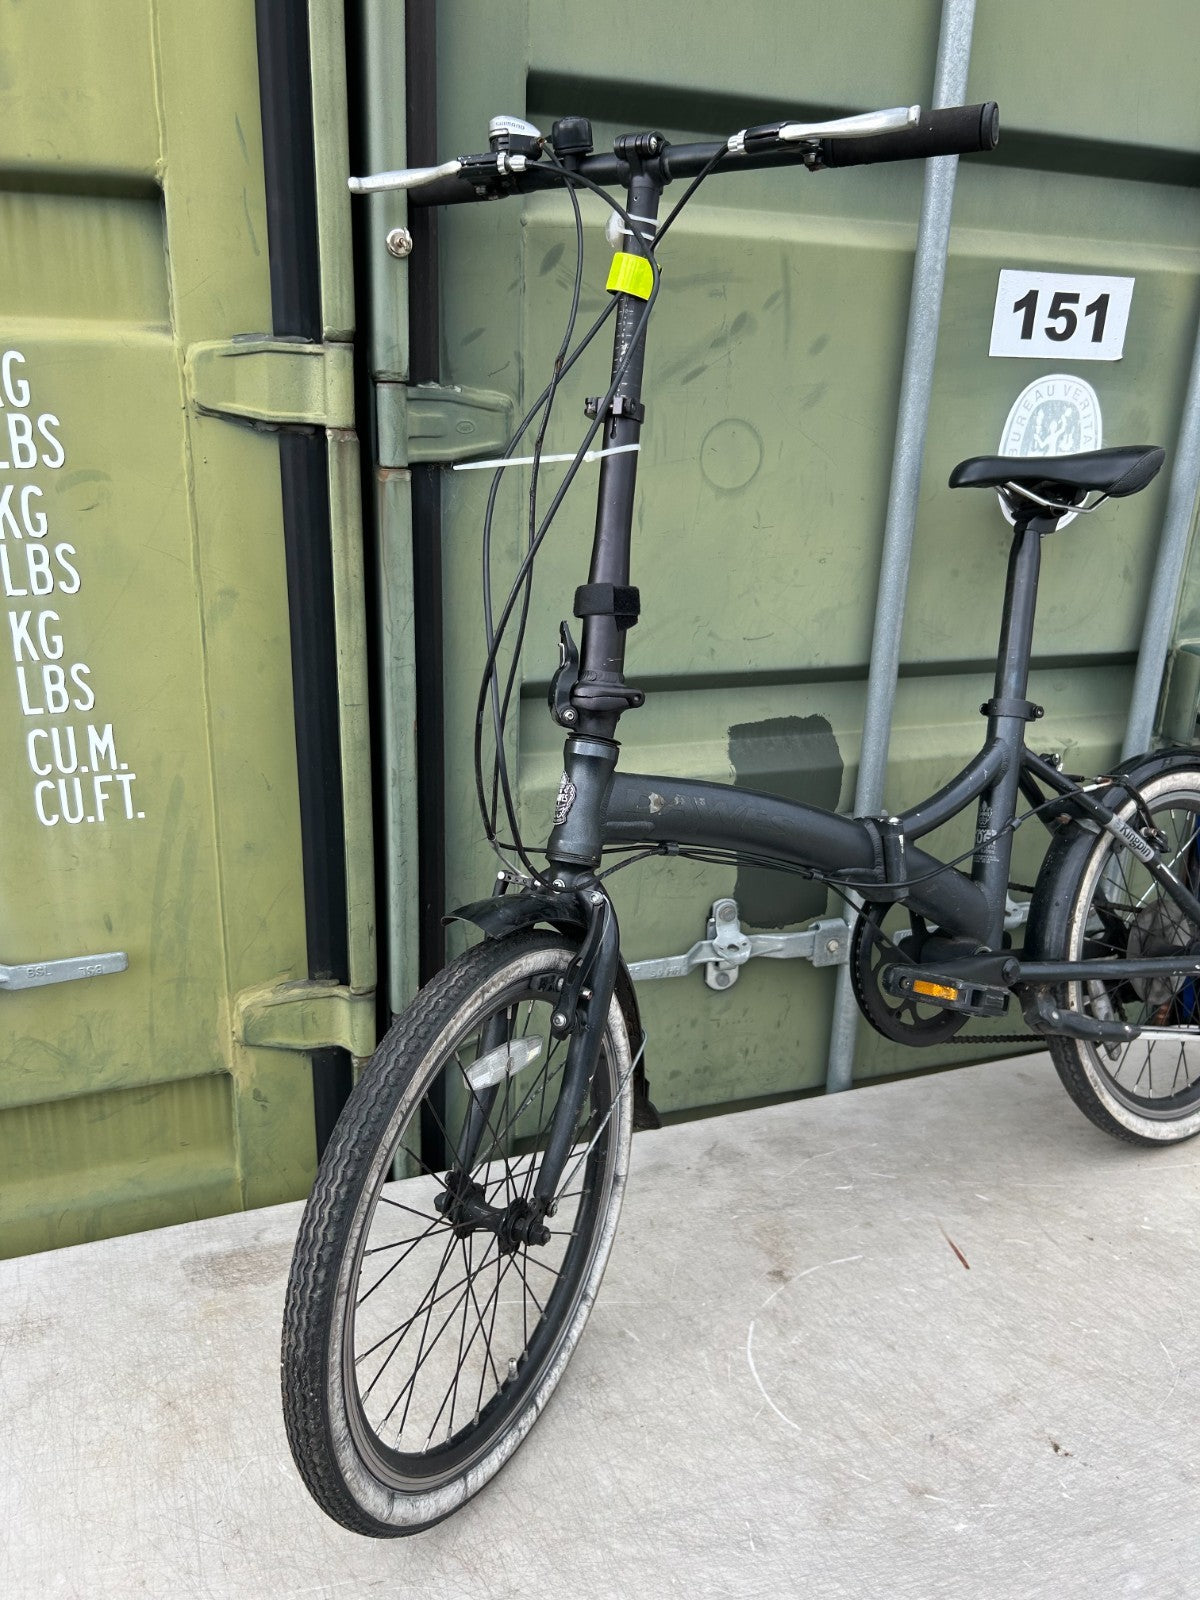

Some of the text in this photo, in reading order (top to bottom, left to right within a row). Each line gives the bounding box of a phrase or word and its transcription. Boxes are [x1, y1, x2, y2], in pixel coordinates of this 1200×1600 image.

[1012, 289, 1111, 343] 151
[0, 350, 31, 408] G
[0, 412, 65, 469] BS
[1009, 384, 1093, 456] BUREAU VERITA
[0, 484, 48, 540] KG
[0, 542, 81, 597] LBS
[9, 609, 64, 662] KG
[17, 662, 95, 716] LBS
[27, 723, 129, 776] CU.M.
[34, 773, 146, 827] CU.FT.
[1120, 825, 1152, 858] Kingpin
